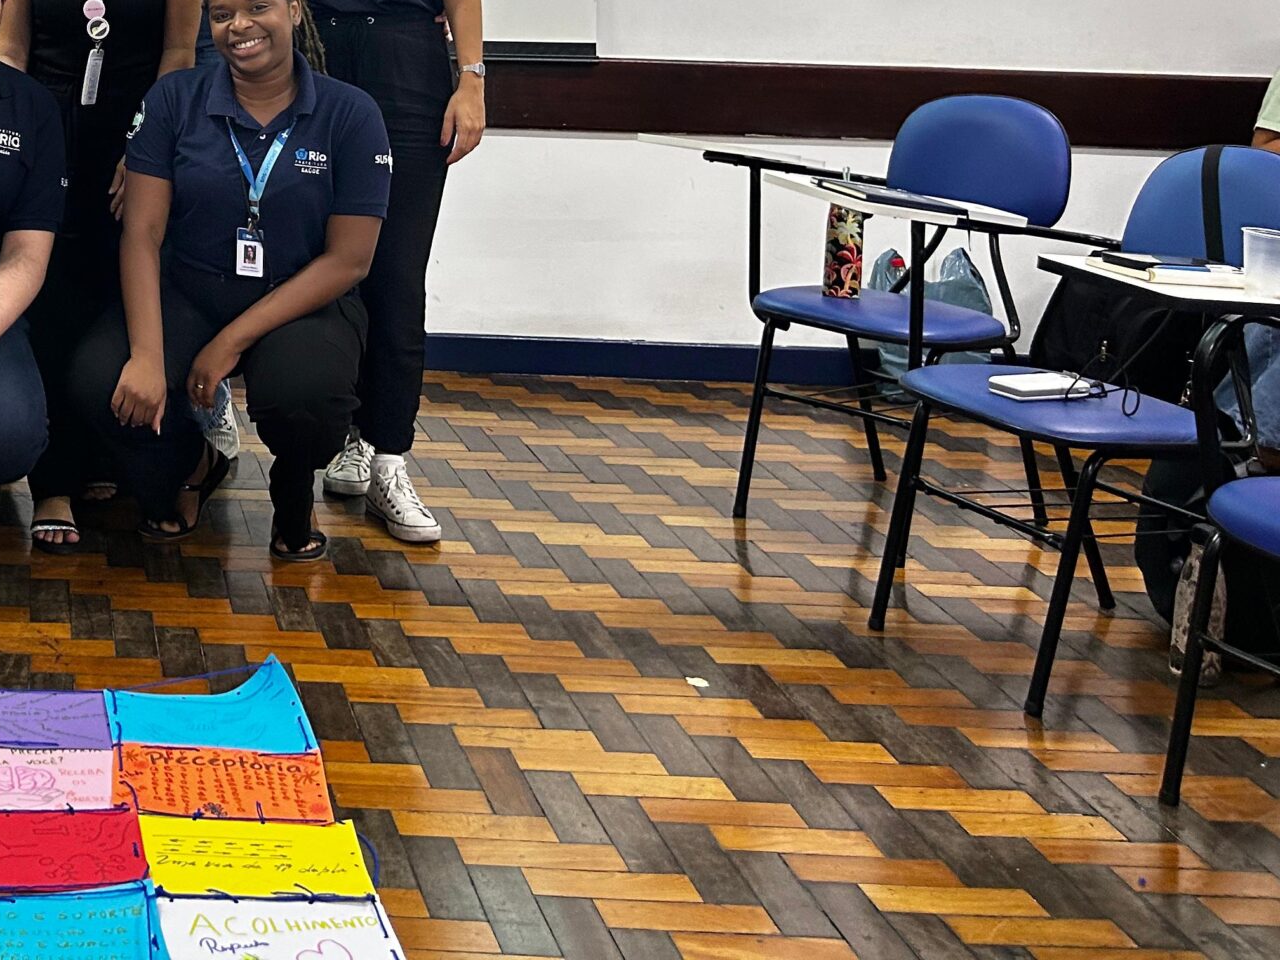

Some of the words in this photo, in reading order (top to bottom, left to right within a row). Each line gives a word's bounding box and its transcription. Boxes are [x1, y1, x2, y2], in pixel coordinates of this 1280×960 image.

[0, 133, 20, 148] RIO
[308, 151, 327, 162] Rio
[374, 154, 388, 164] SUS
[27, 756, 64, 765] VOCÊ?
[145, 751, 301, 773] Preceptoria
